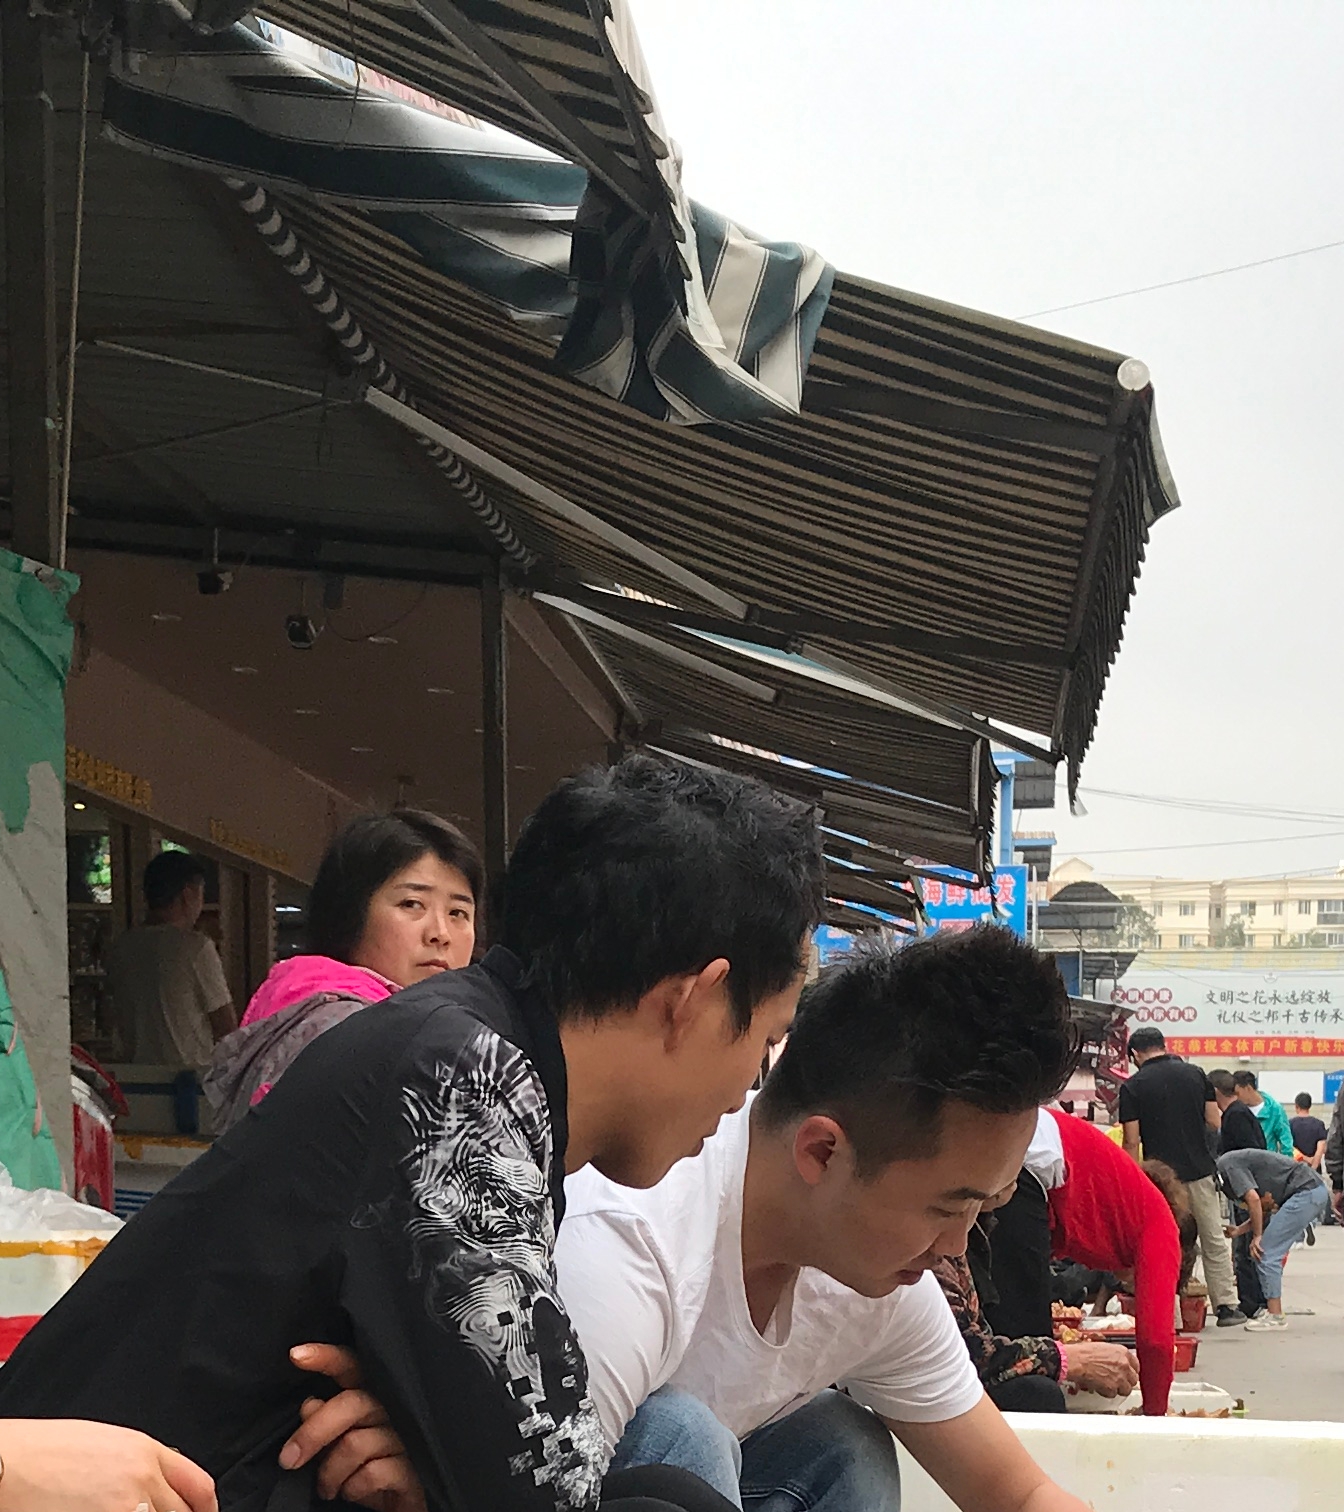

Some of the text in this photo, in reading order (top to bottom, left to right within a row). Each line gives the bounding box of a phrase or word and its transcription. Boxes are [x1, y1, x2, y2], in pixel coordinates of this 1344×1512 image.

[1206, 989, 1332, 1005] 文明之花永远绽放
[1216, 1008, 1344, 1025] 礼仪之邦千古传承
